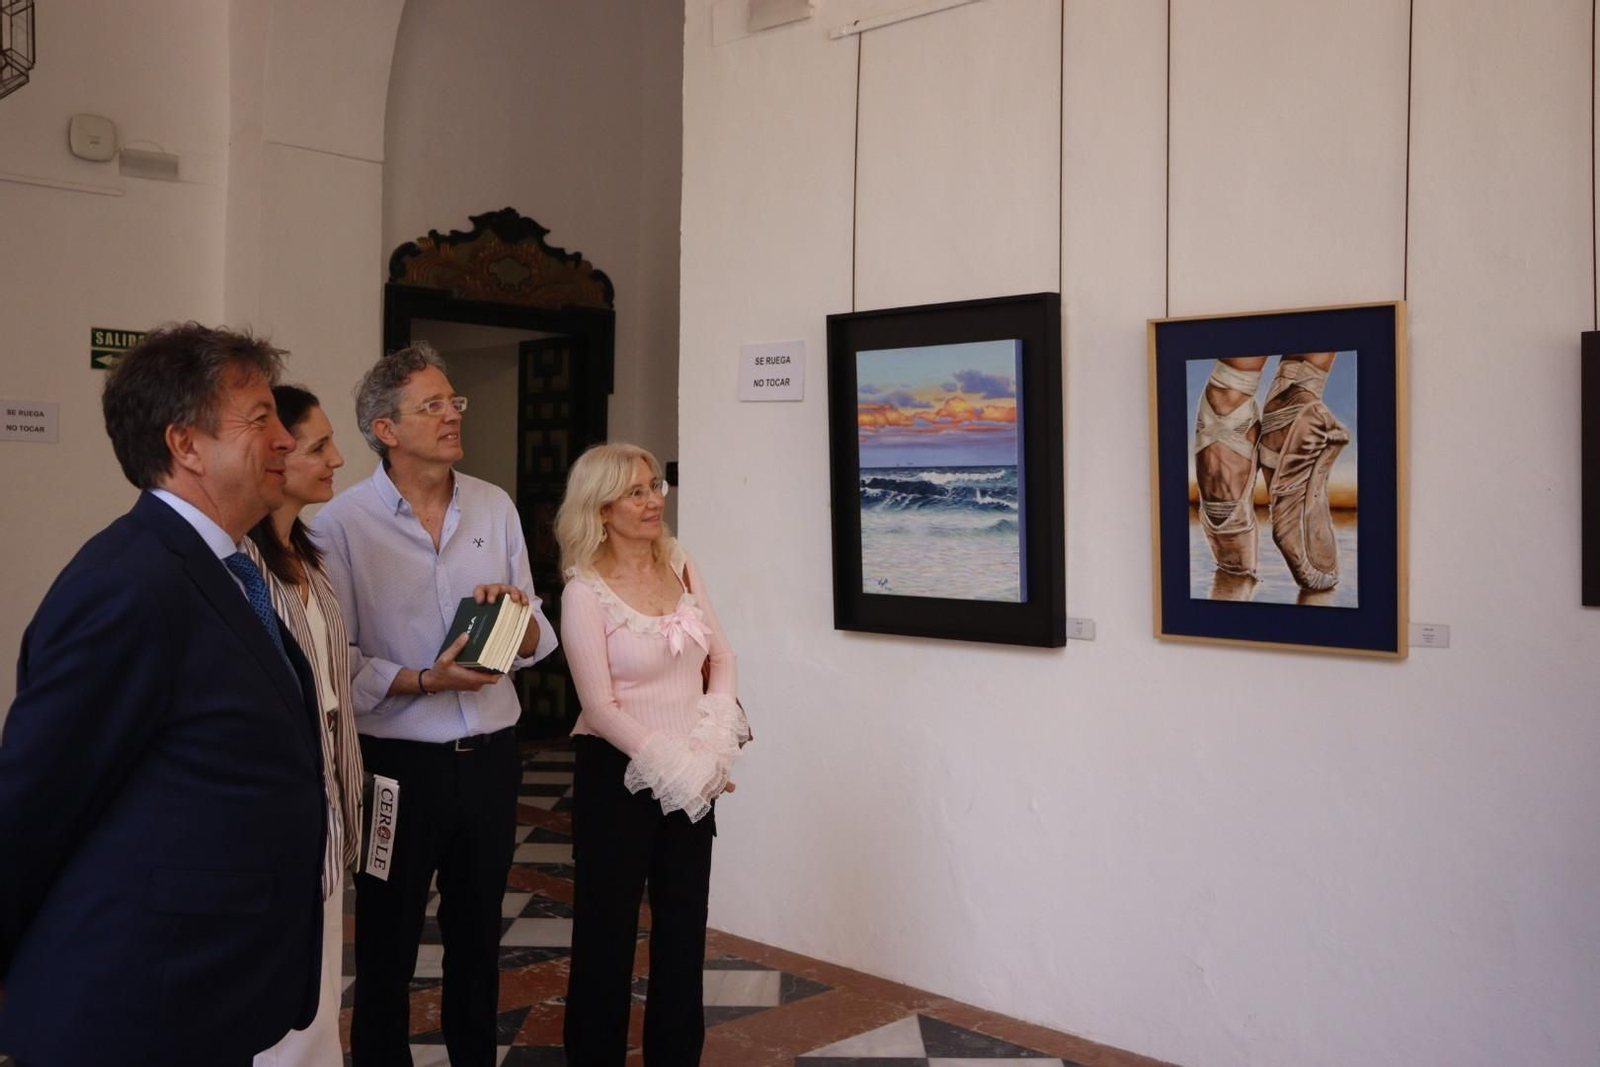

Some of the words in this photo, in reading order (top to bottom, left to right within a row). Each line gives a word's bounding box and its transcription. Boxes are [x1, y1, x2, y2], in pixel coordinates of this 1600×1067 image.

[754, 357, 765, 366] SE
[765, 355, 791, 365] RUEGA
[753, 379, 765, 388] NO
[766, 377, 791, 387] TOCAR
[18, 410, 45, 418] RUEGA
[6, 424, 18, 432] NO
[19, 425, 45, 433] TOCAR
